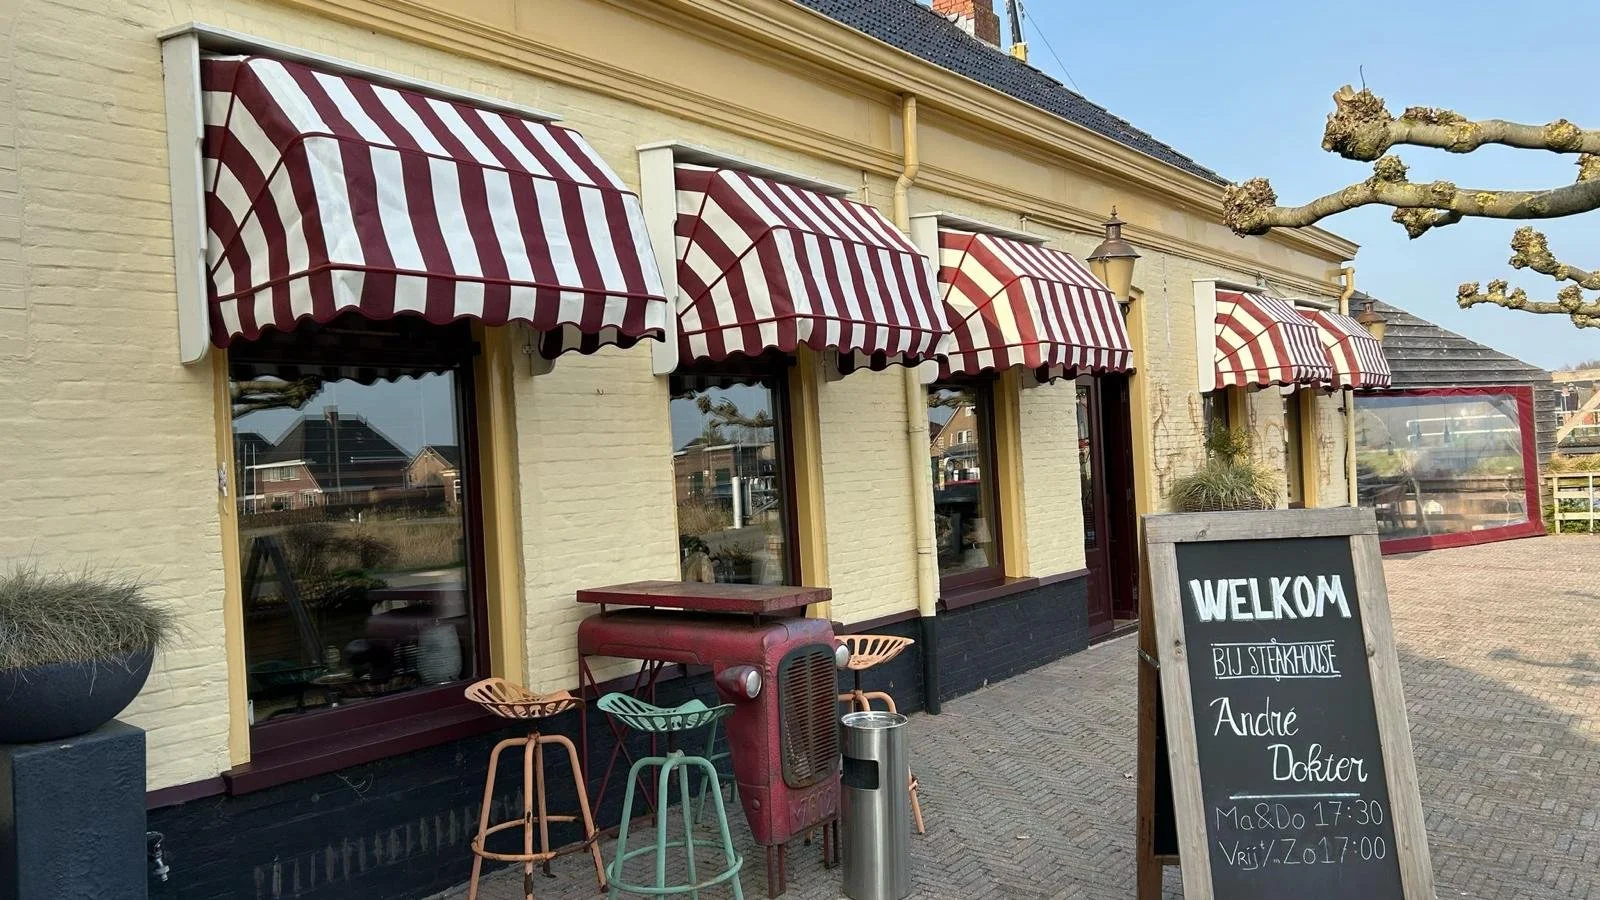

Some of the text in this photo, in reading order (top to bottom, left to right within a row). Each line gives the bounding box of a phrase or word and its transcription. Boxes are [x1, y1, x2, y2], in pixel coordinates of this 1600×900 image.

[1189, 574, 1352, 622] WELKOM
[1212, 643, 1341, 676] BIJ STEAKHOUSE
[1209, 696, 1299, 737] André
[1267, 743, 1368, 783] Dokter
[1215, 799, 1384, 831] Ma&Do 17:30
[1317, 836, 1387, 864] 17:00
